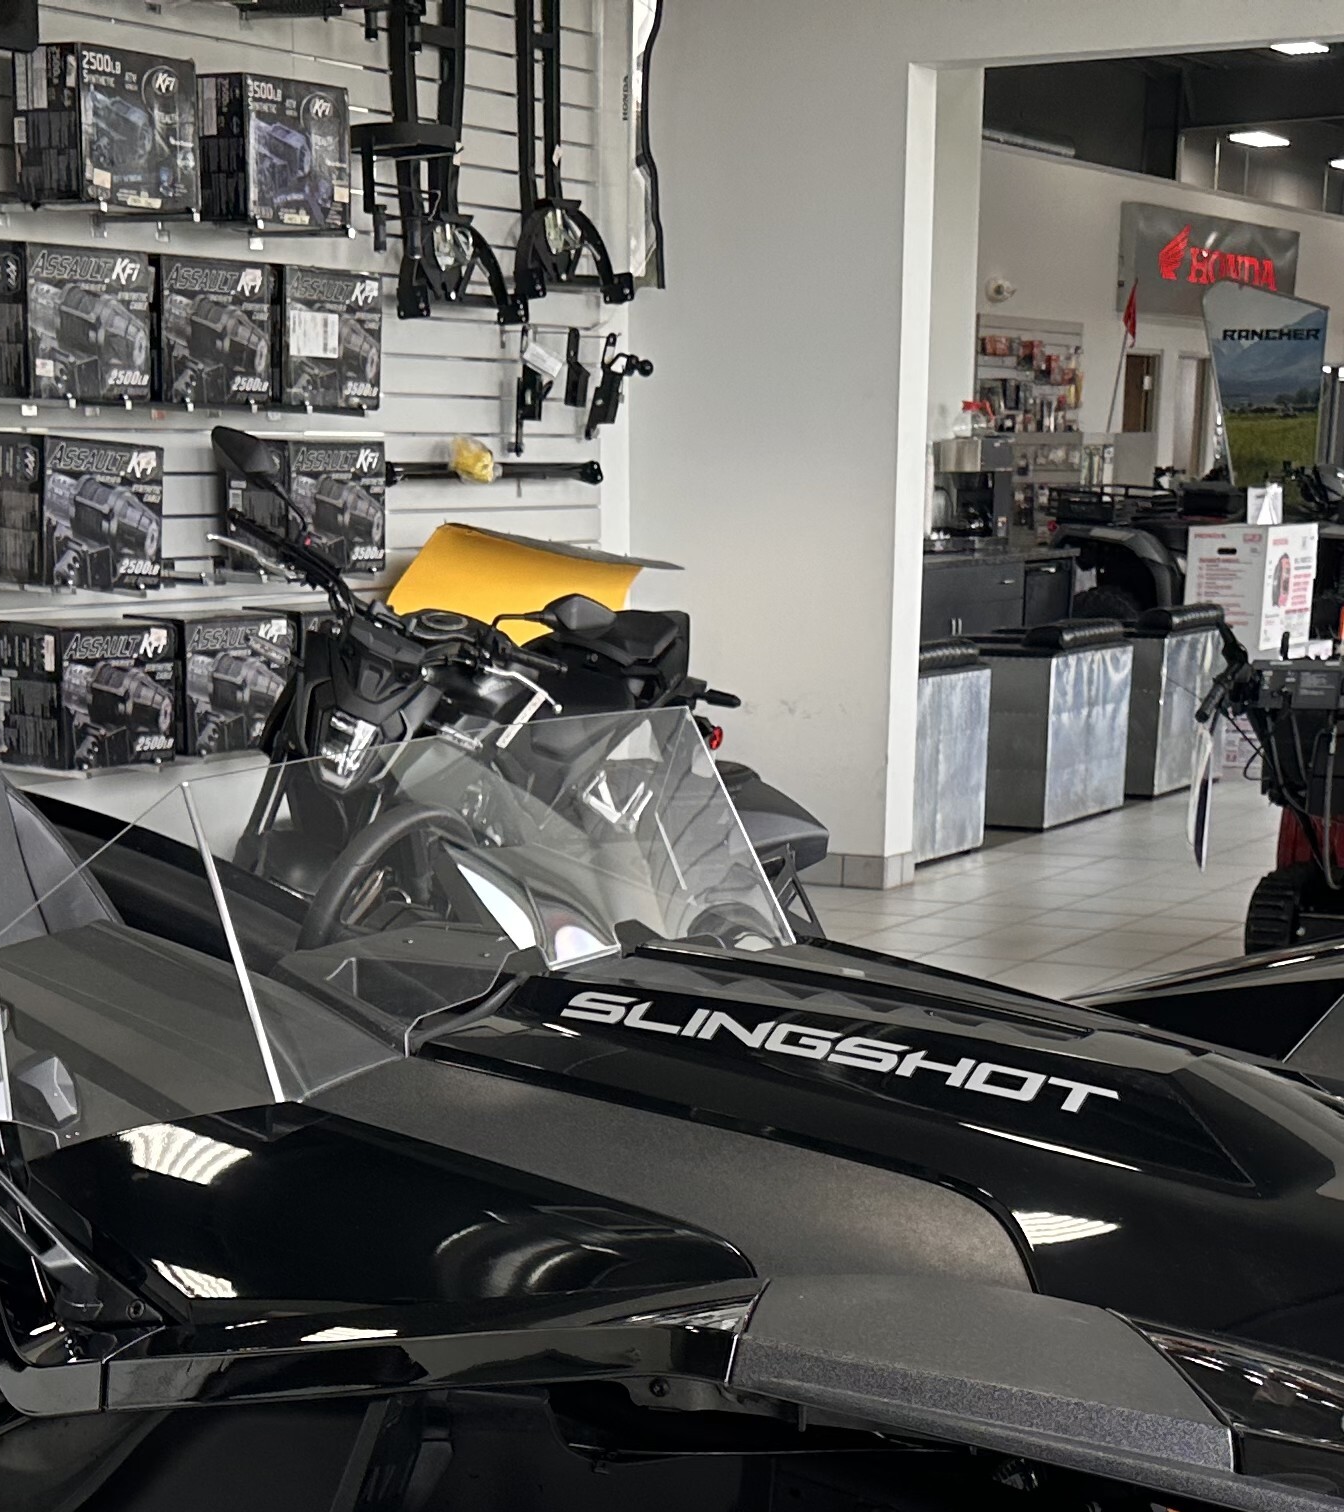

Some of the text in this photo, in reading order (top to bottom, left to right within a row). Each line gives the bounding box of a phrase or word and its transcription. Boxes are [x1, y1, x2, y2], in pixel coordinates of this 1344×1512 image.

[82, 51, 122, 75] 2500LB
[29, 250, 114, 281] ASSAULT
[164, 263, 239, 293] ASSAULT
[1188, 246, 1277, 292] HONDA
[288, 272, 354, 301] ASSAULT
[1222, 328, 1321, 341] RANCHER
[108, 368, 150, 386] 2500LB
[46, 442, 130, 473] ASSAULT
[292, 447, 357, 472] ASSAULT
[120, 558, 161, 576] 2500LB
[63, 632, 142, 660] ASSAULT
[136, 735, 174, 752] 2500LB
[560, 991, 1119, 1114] SLINGSHOT
